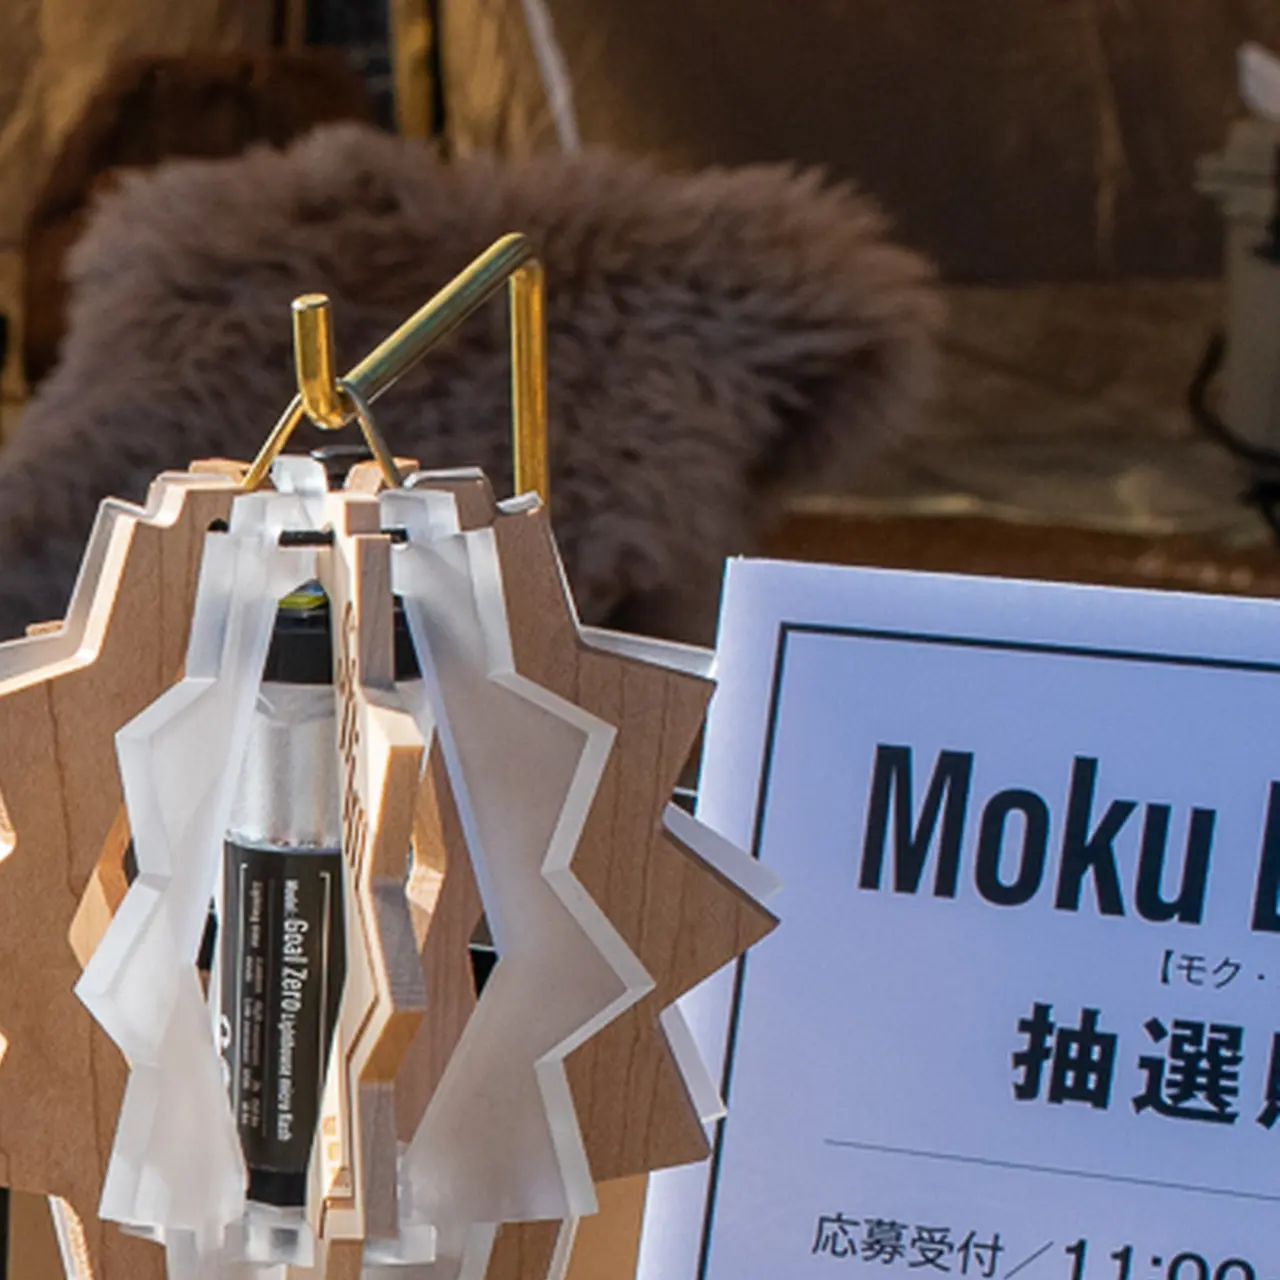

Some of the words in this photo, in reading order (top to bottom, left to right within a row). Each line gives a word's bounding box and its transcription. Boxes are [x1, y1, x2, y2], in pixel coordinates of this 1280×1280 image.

[858, 743, 1218, 925] Moku
[283, 920, 310, 964] Goal
[280, 967, 310, 1012] Zero
